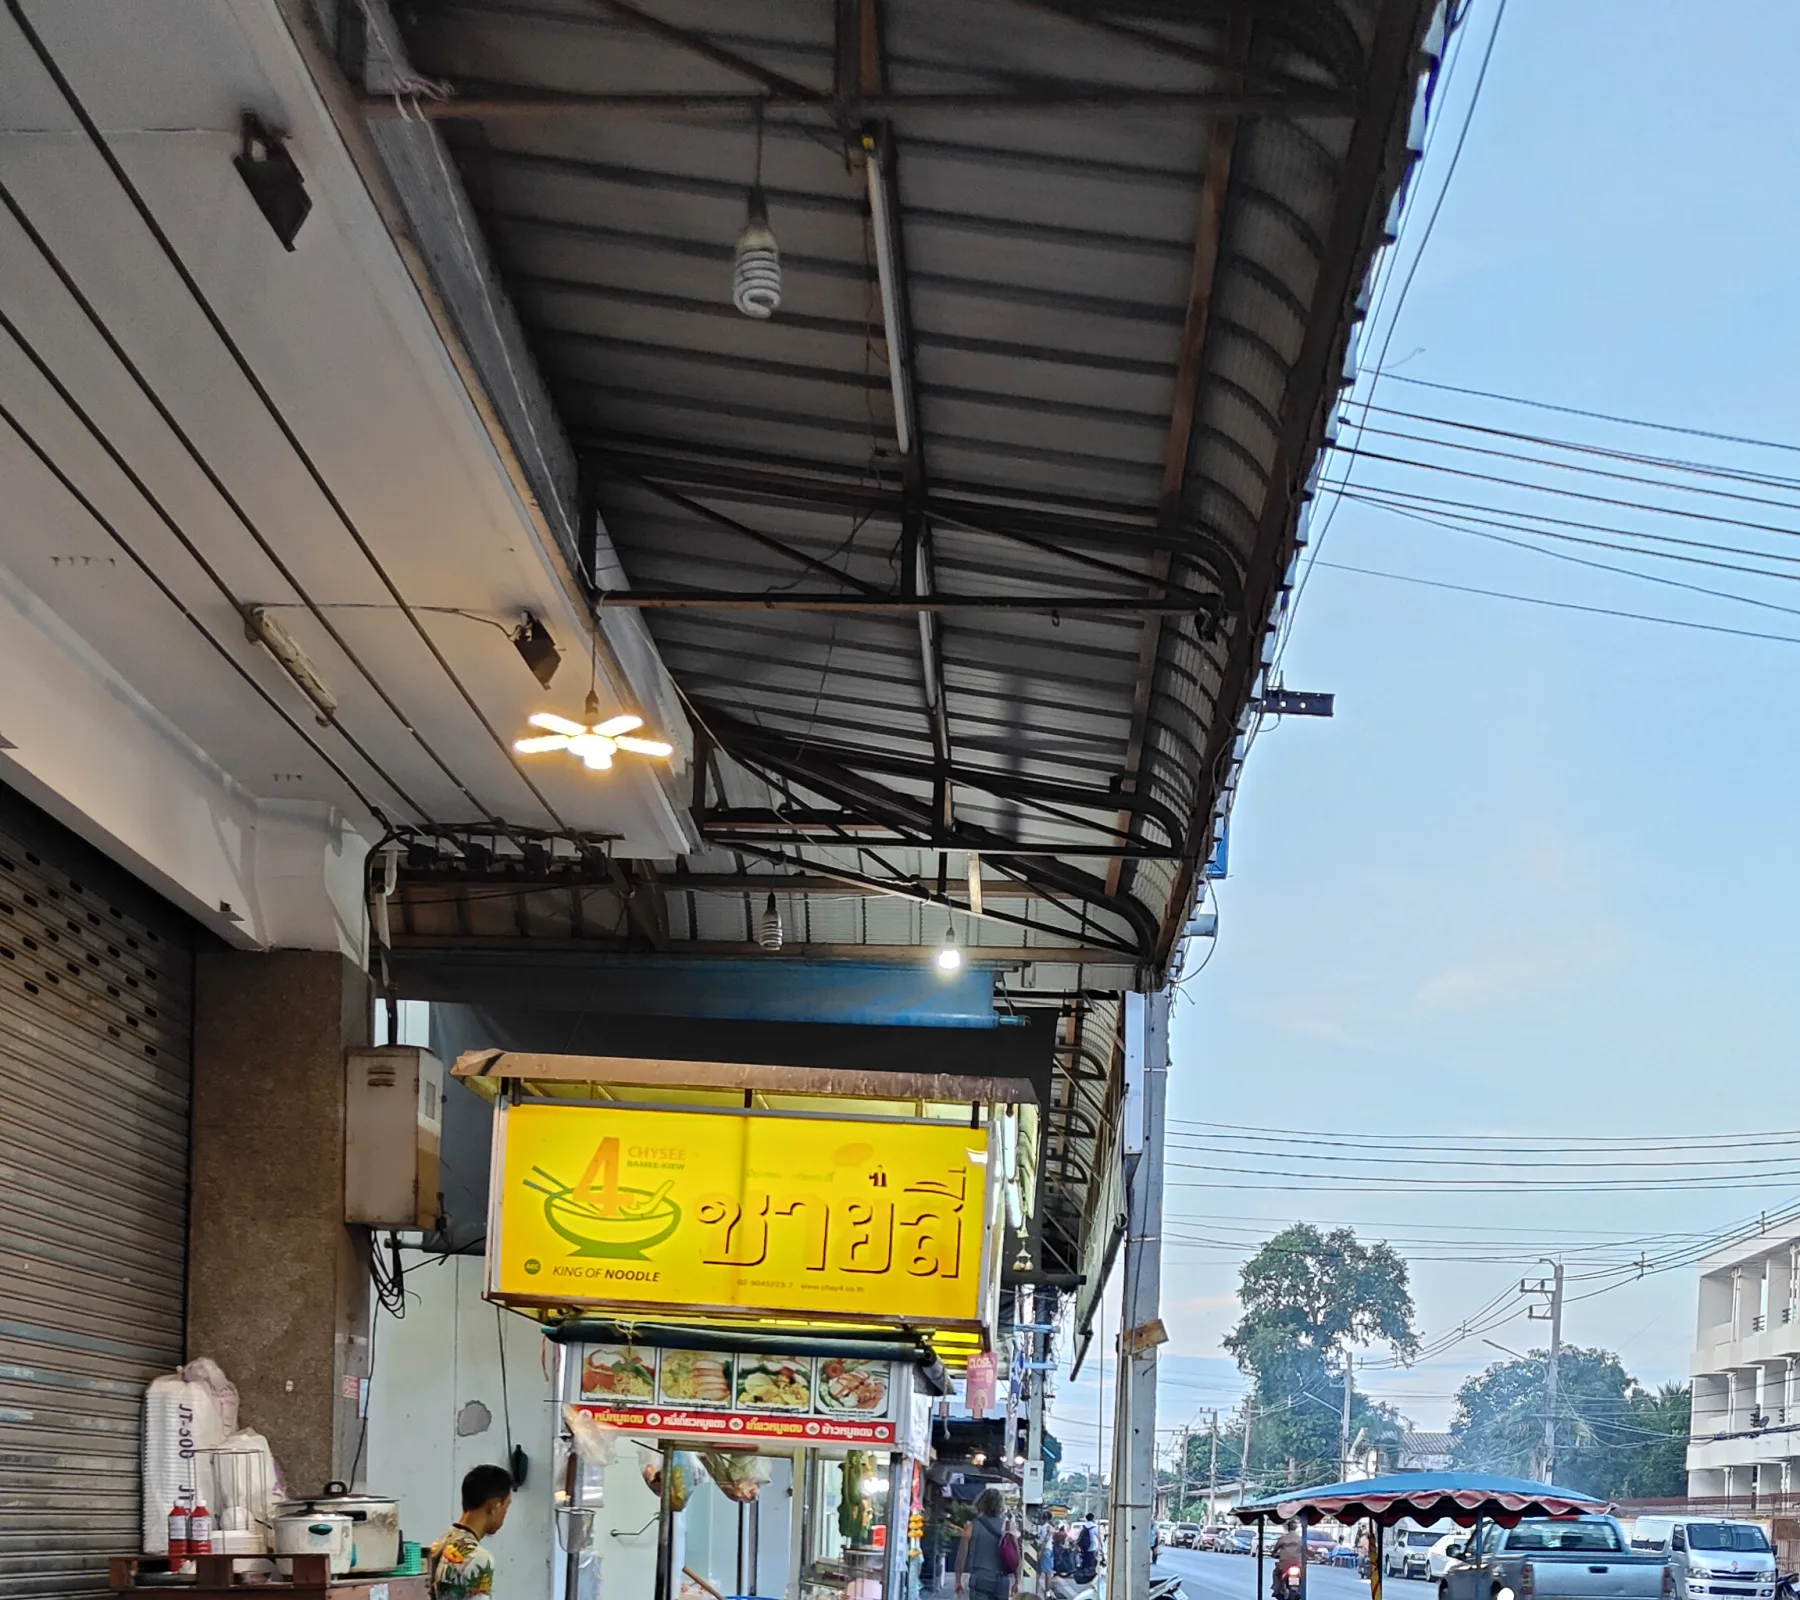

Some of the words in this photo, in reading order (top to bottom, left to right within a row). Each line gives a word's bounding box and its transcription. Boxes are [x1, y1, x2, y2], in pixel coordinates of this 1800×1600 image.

[627, 1146, 687, 1161] CHYSEE
[572, 1136, 636, 1217] 4
[552, 1265, 583, 1278] KING
[585, 1267, 602, 1278] OF
[604, 1268, 661, 1282] NOODLE
